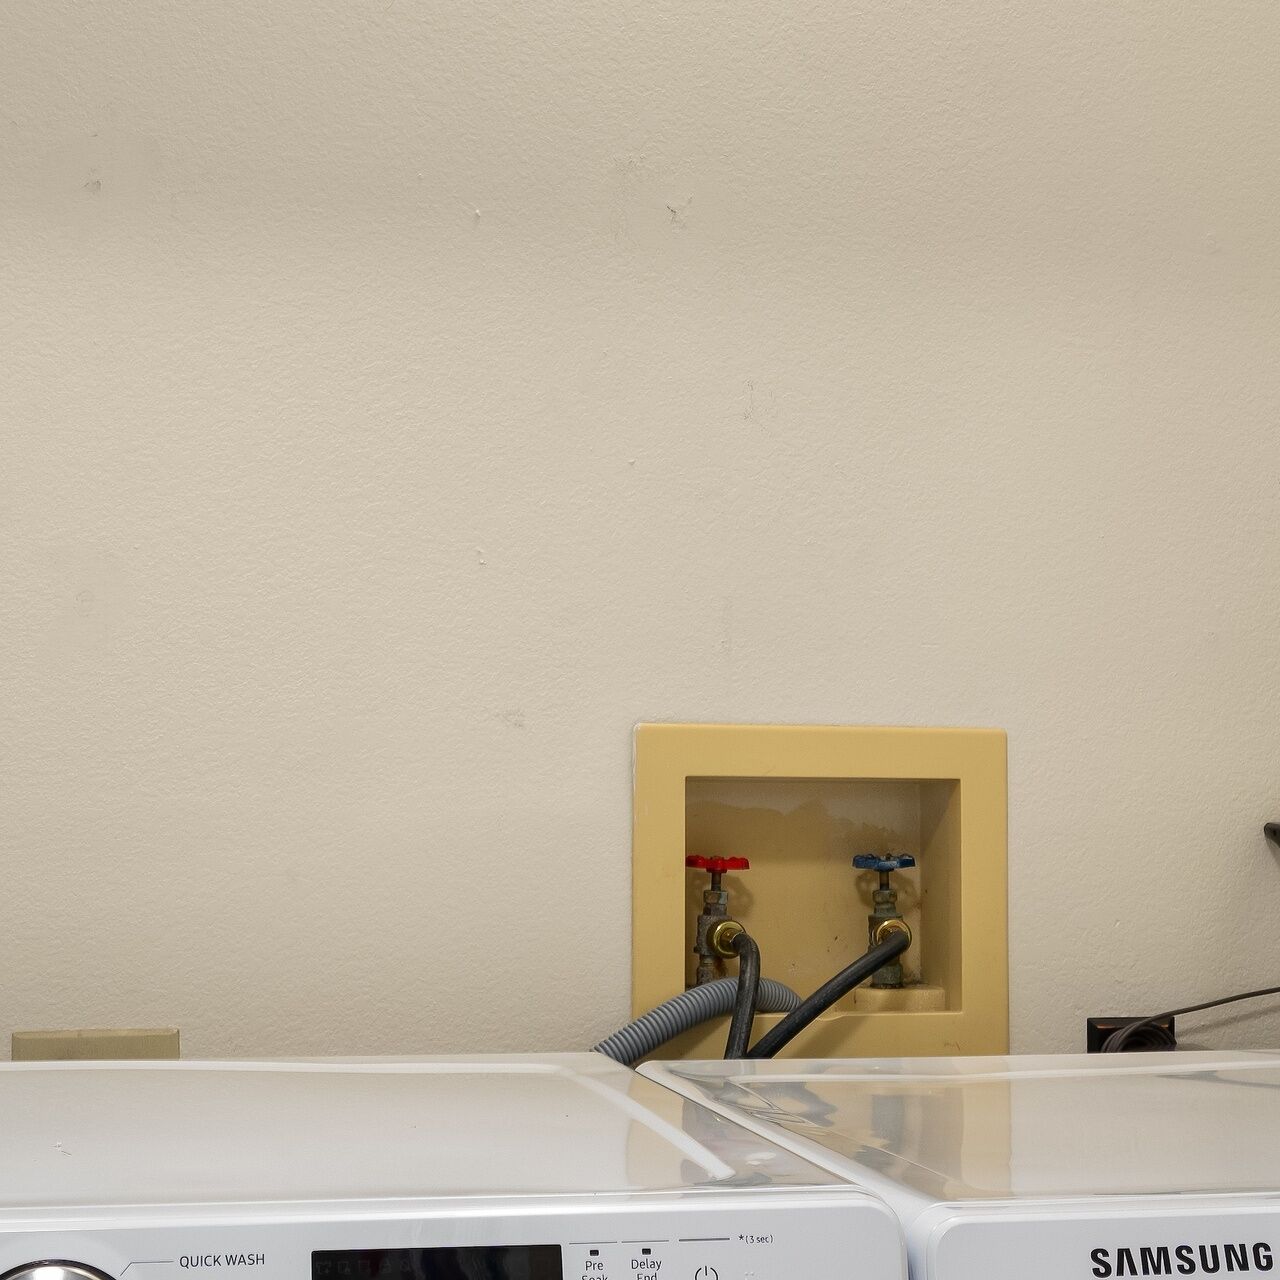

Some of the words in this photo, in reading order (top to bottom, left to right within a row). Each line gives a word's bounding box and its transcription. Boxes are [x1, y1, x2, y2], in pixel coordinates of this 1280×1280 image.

[756, 1234, 774, 1244] sec)
[180, 1255, 222, 1269] QUICK
[225, 1254, 265, 1266] WASH
[585, 1261, 604, 1271] Pre
[631, 1259, 662, 1271] Delay
[1090, 1242, 1274, 1278] SAMSUNG
